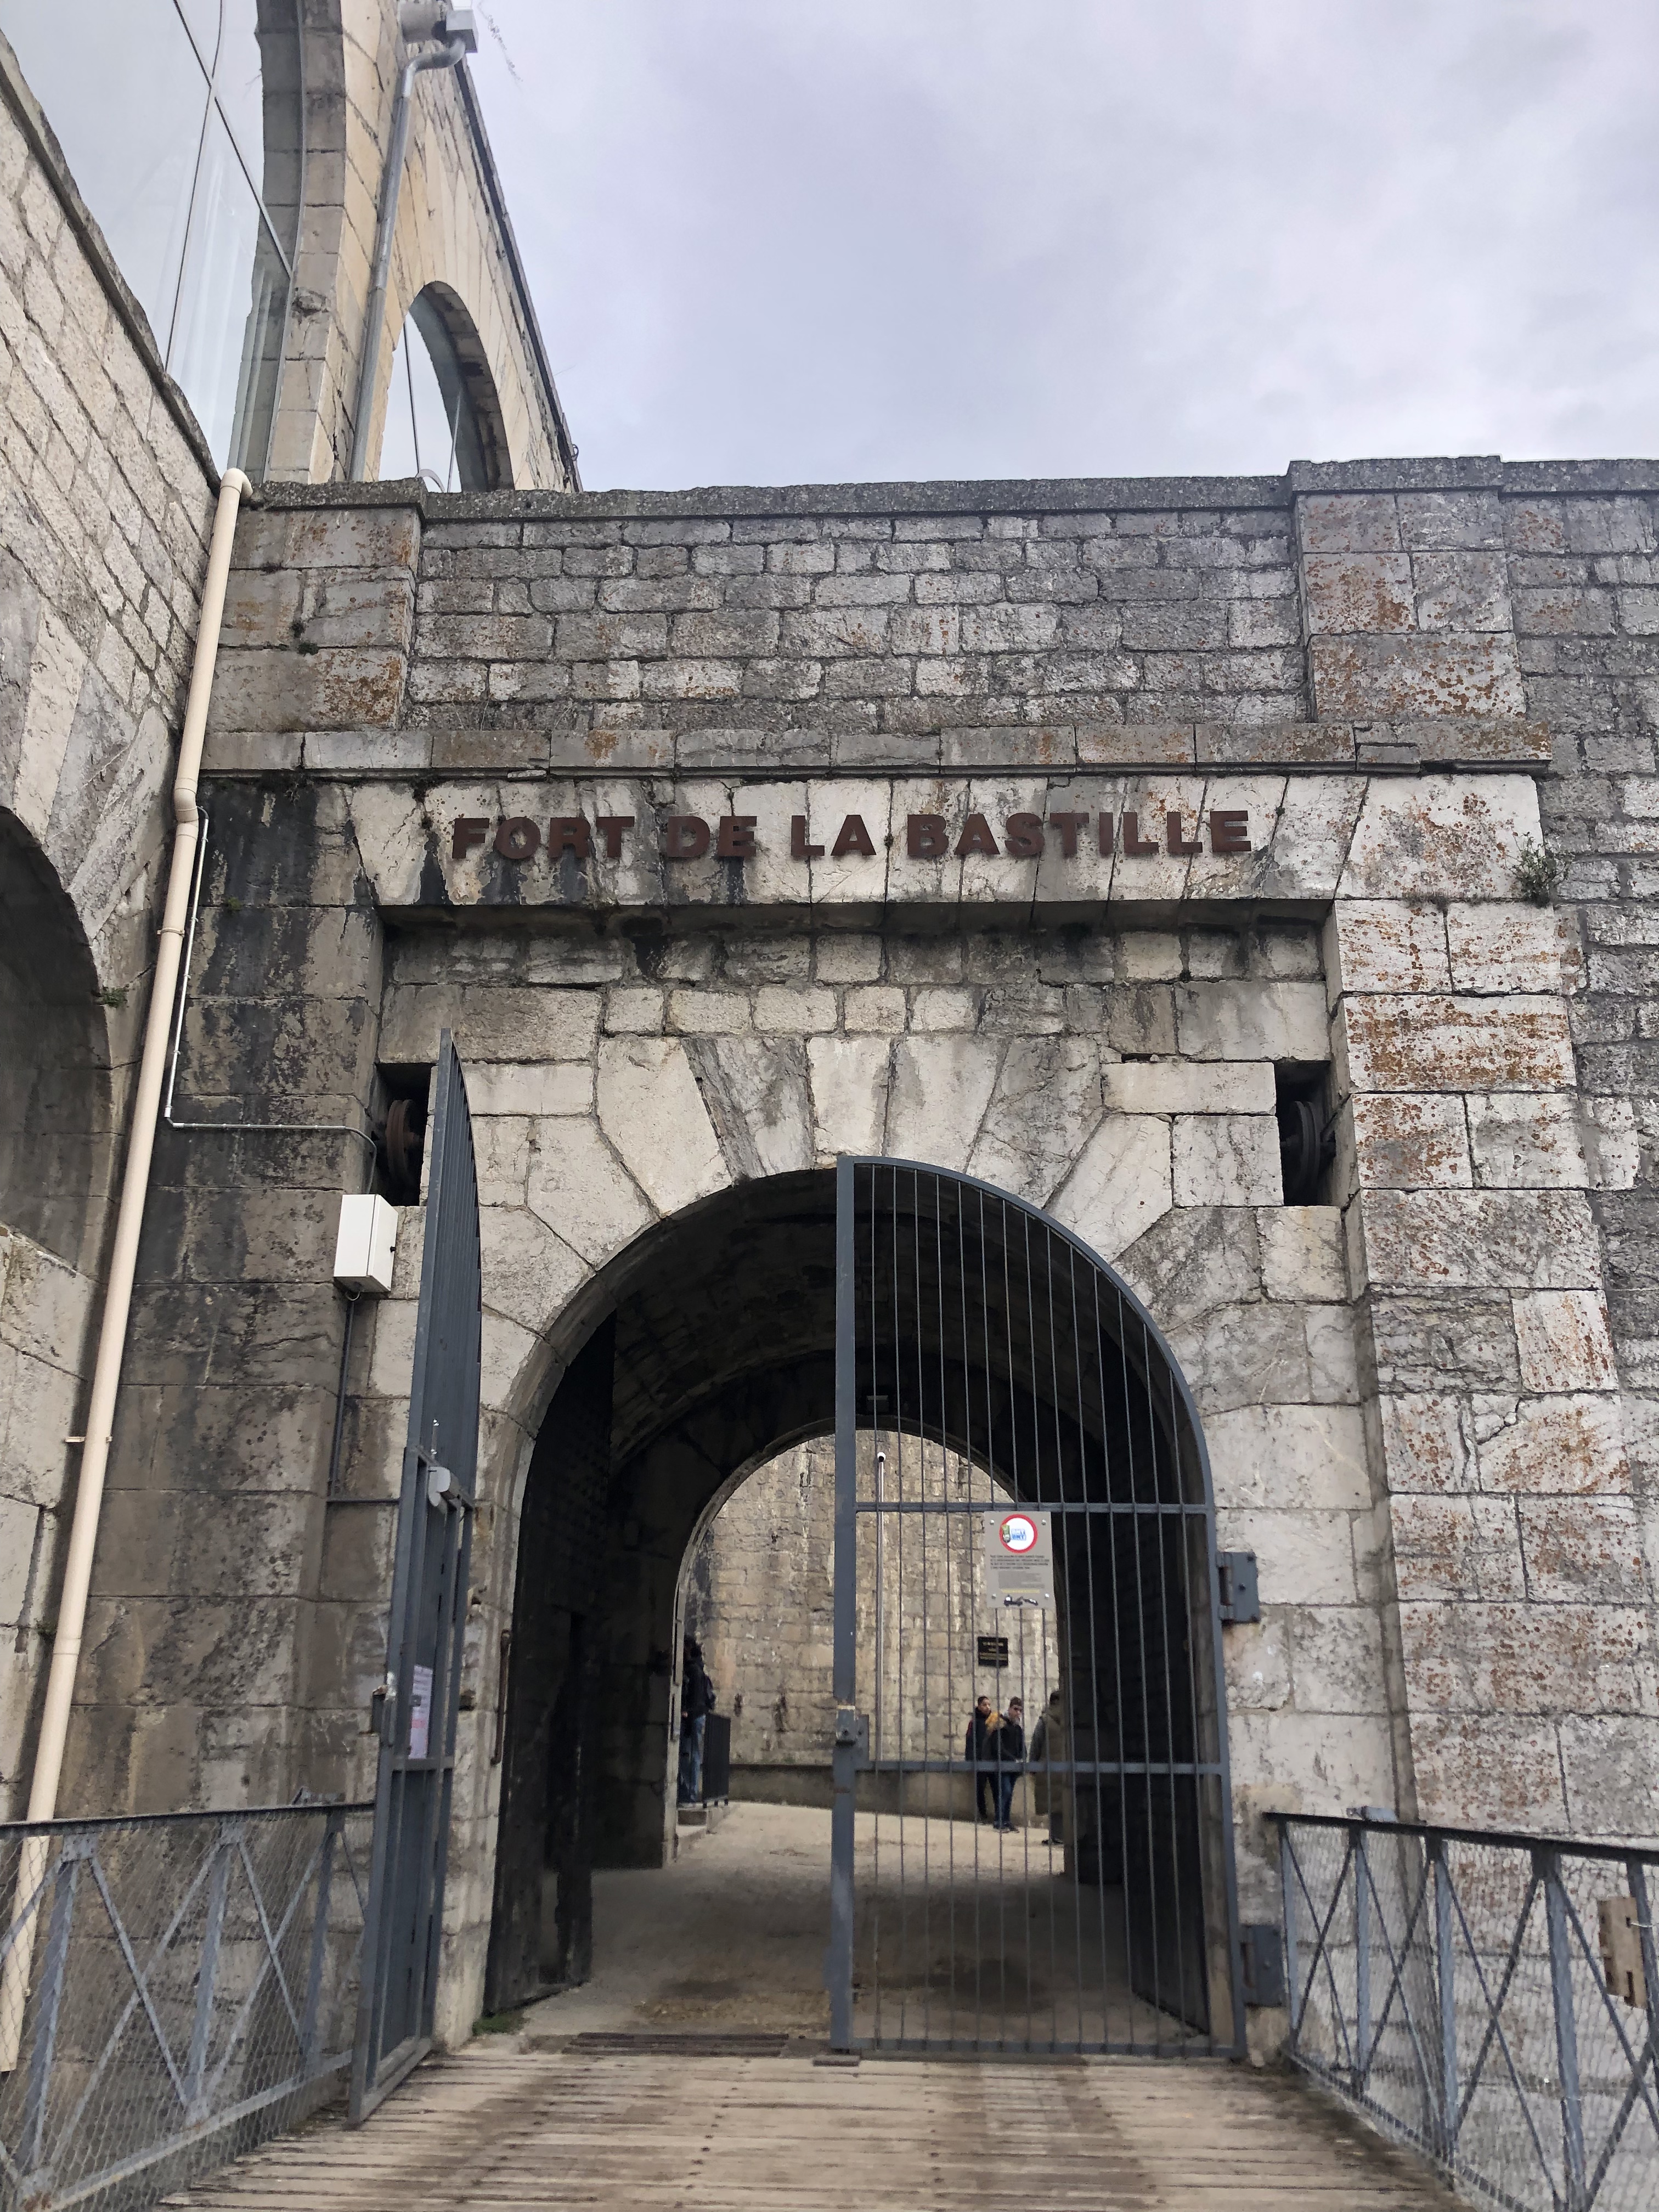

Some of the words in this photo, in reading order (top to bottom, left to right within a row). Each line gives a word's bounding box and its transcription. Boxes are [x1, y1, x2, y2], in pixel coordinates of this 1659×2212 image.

[452, 816, 635, 860] FORT
[667, 816, 757, 857] DE
[791, 815, 877, 856] LA
[907, 810, 1252, 856] BASTILLE
